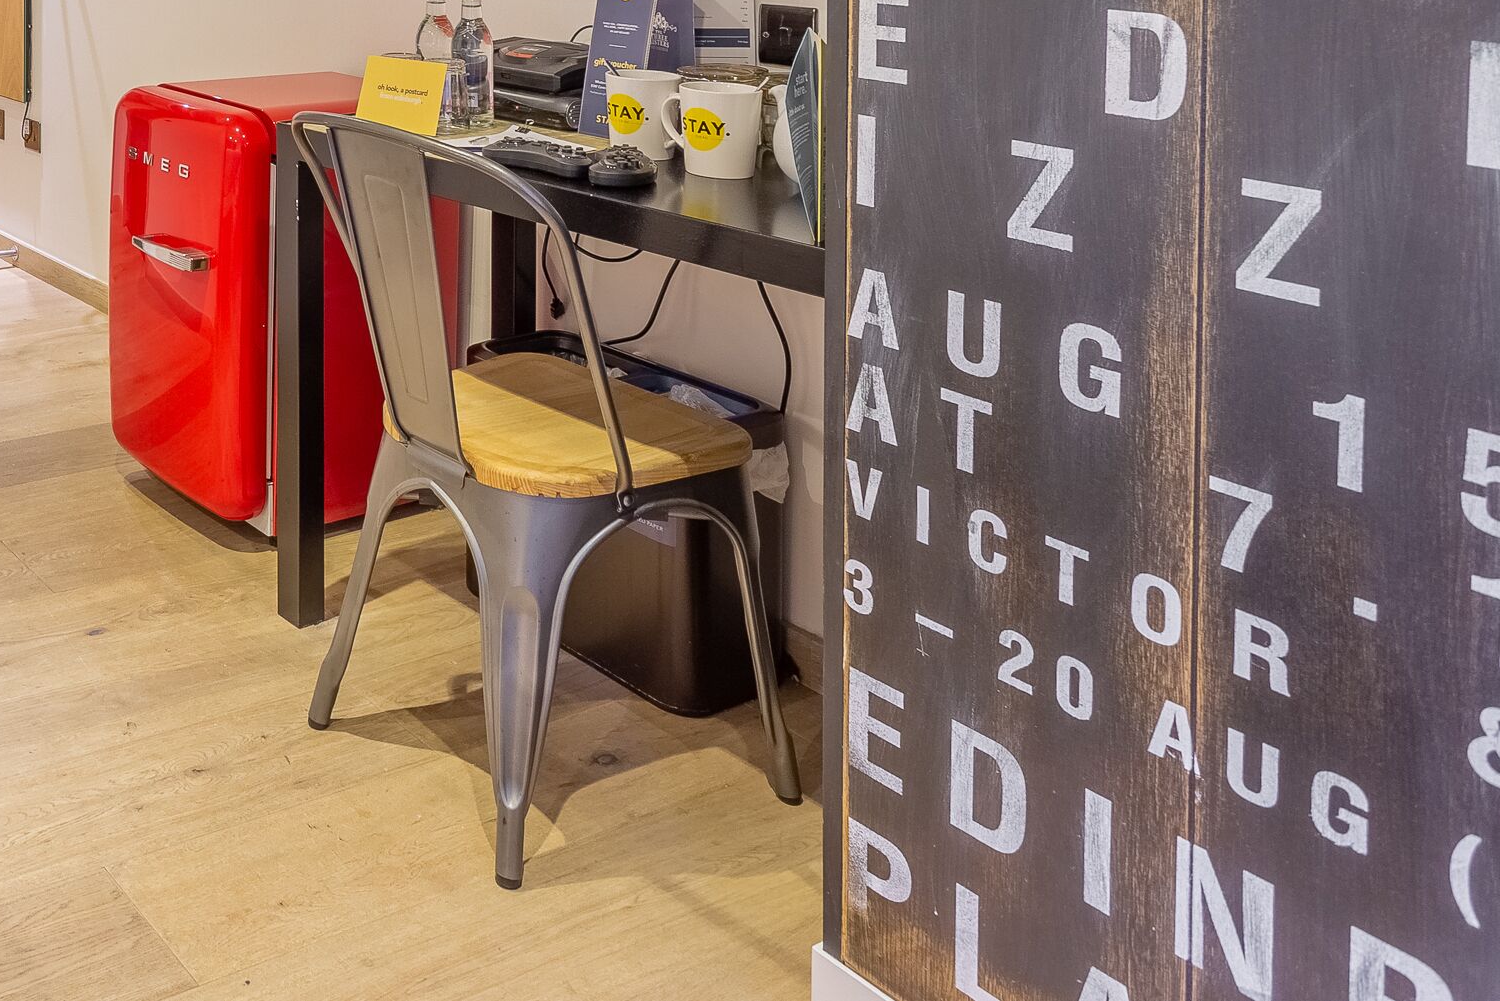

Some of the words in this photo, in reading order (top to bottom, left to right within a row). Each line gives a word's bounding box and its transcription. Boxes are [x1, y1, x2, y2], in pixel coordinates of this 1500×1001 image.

[385, 85, 400, 93] look,
[404, 88, 429, 96] postcard
[682, 116, 730, 136] STAY.
[128, 145, 190, 178] SMEG
[846, 269, 1122, 418] AUG
[845, 363, 993, 475] AT
[844, 459, 1292, 697] VICTOR
[997, 629, 1094, 721] 20
[1146, 700, 1369, 855] AUG
[846, 816, 1136, 1001] PL
